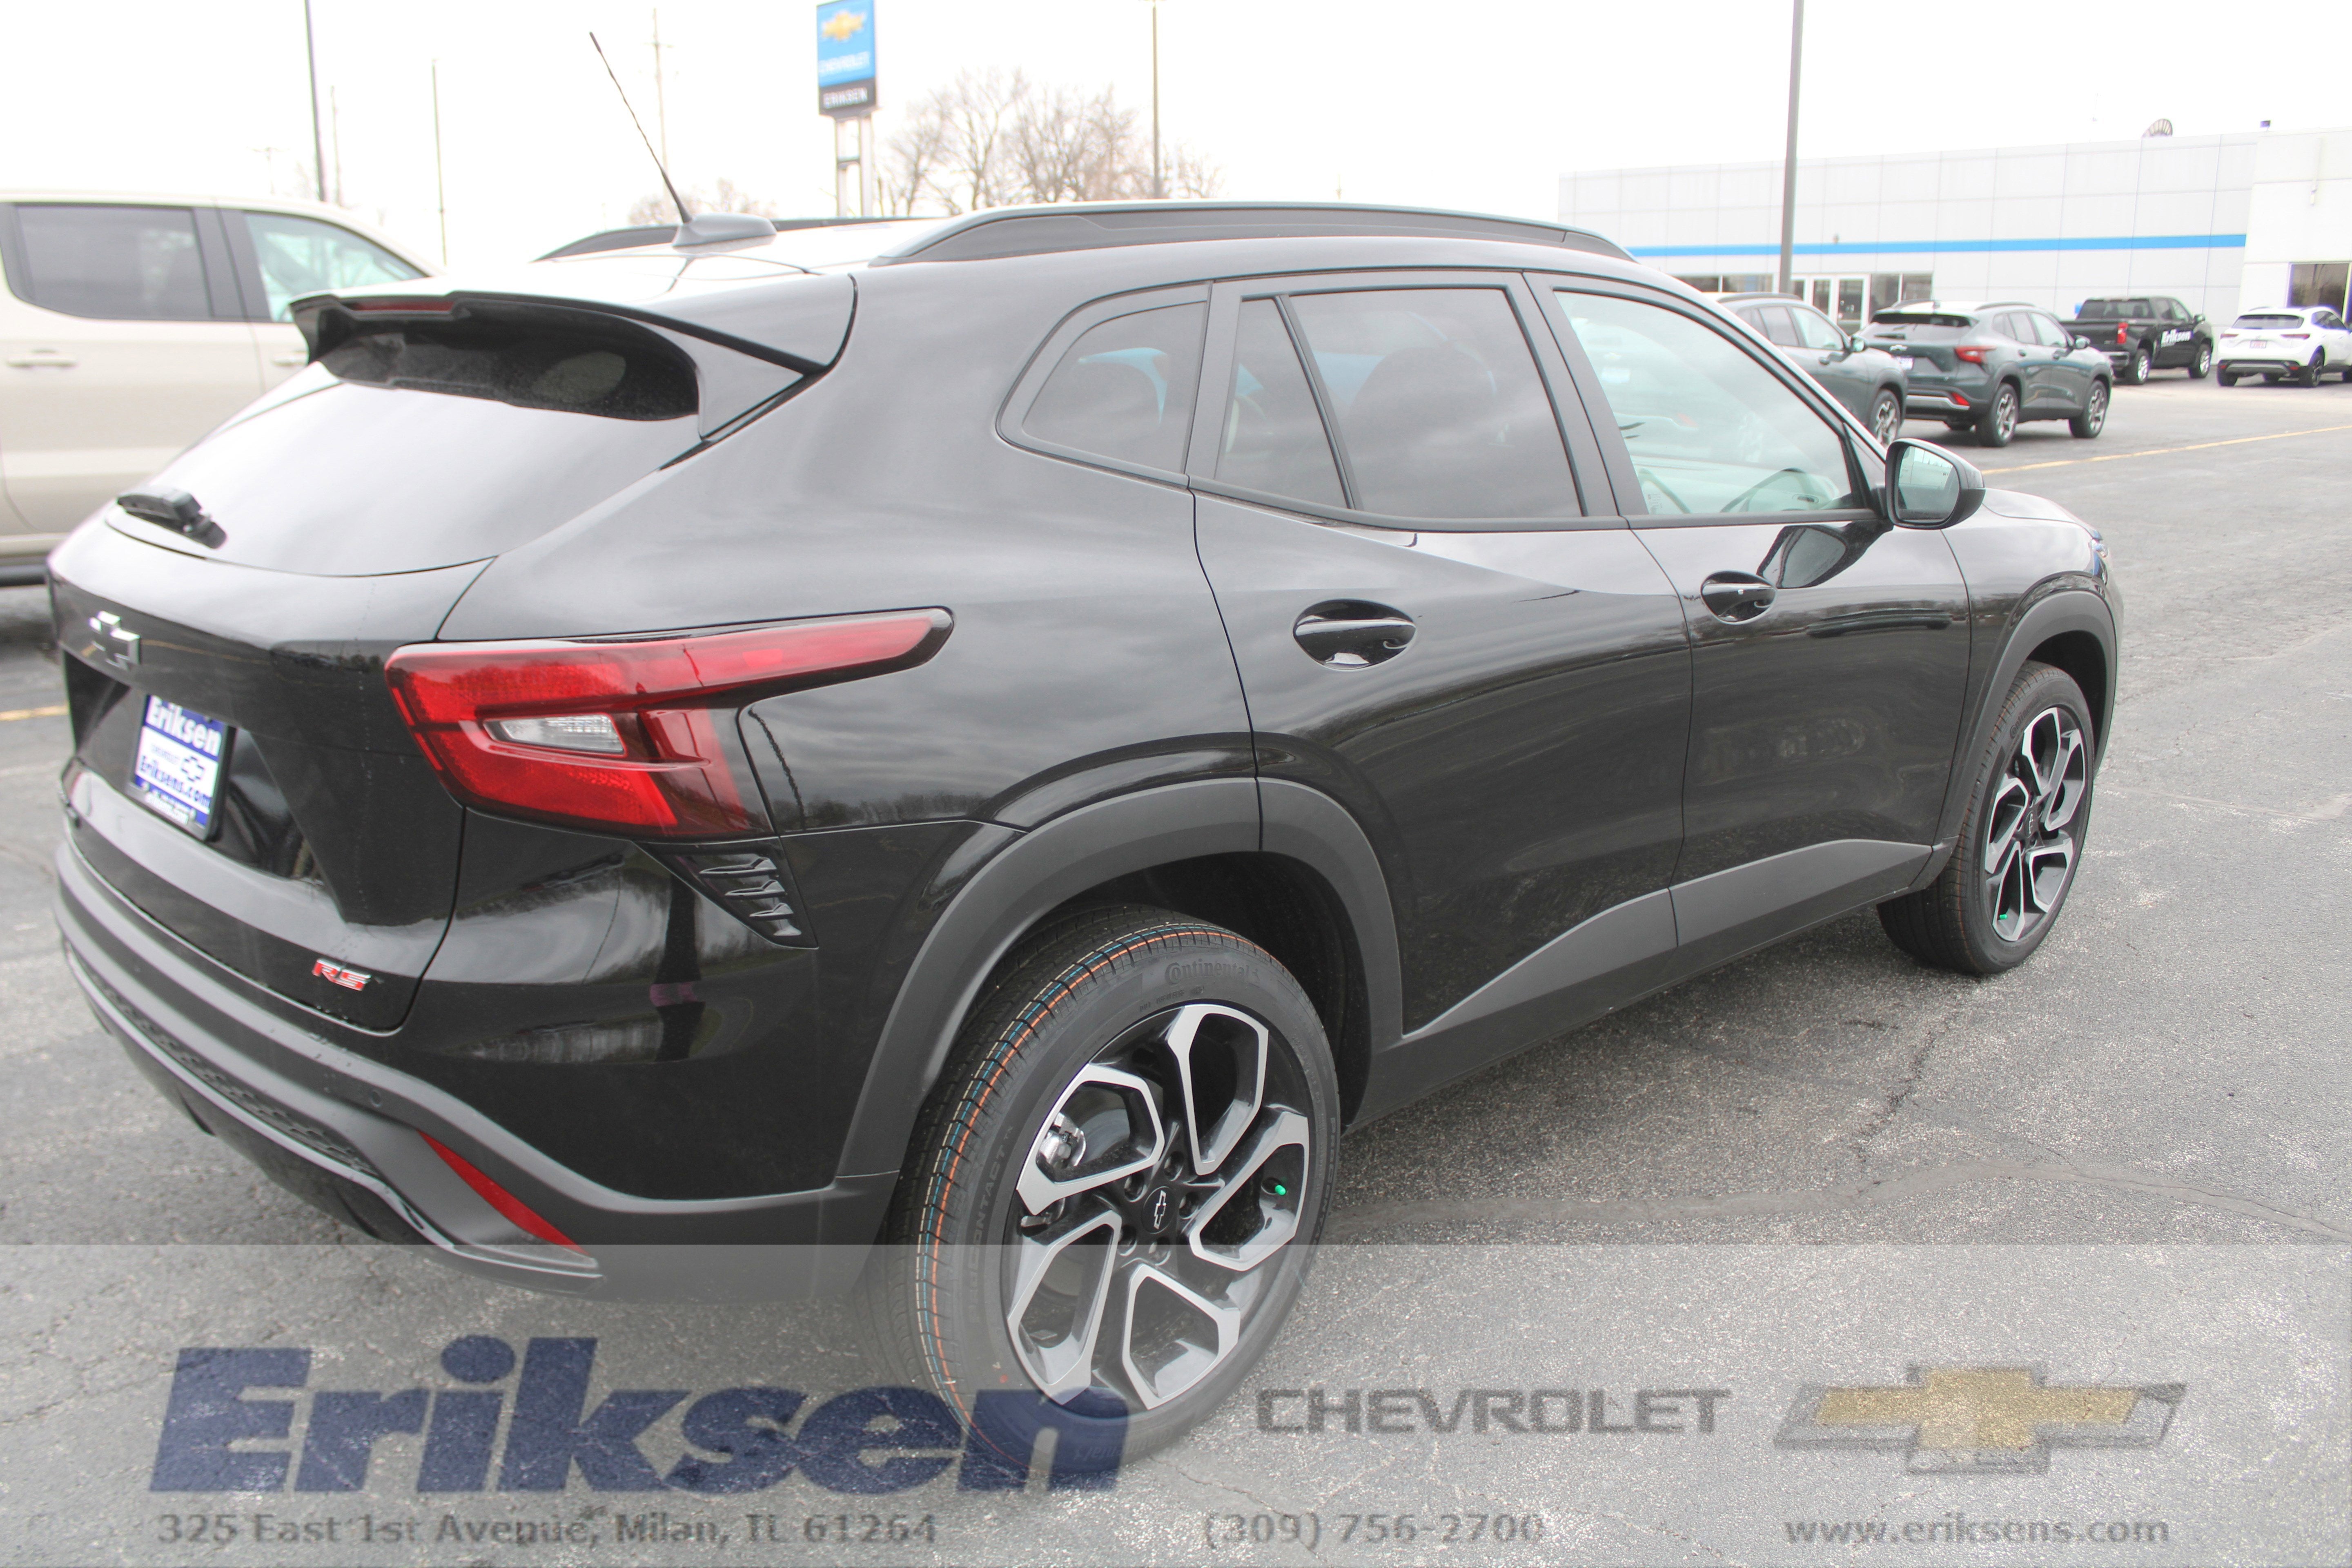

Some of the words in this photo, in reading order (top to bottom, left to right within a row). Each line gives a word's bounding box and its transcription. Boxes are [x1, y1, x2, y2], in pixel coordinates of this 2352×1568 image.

[823, 87, 868, 109] ERIKSEN
[146, 695, 222, 756] Eriksen
[138, 755, 211, 808] Eriksens.com
[312, 957, 372, 991] RS
[1164, 958, 1250, 985] Continental
